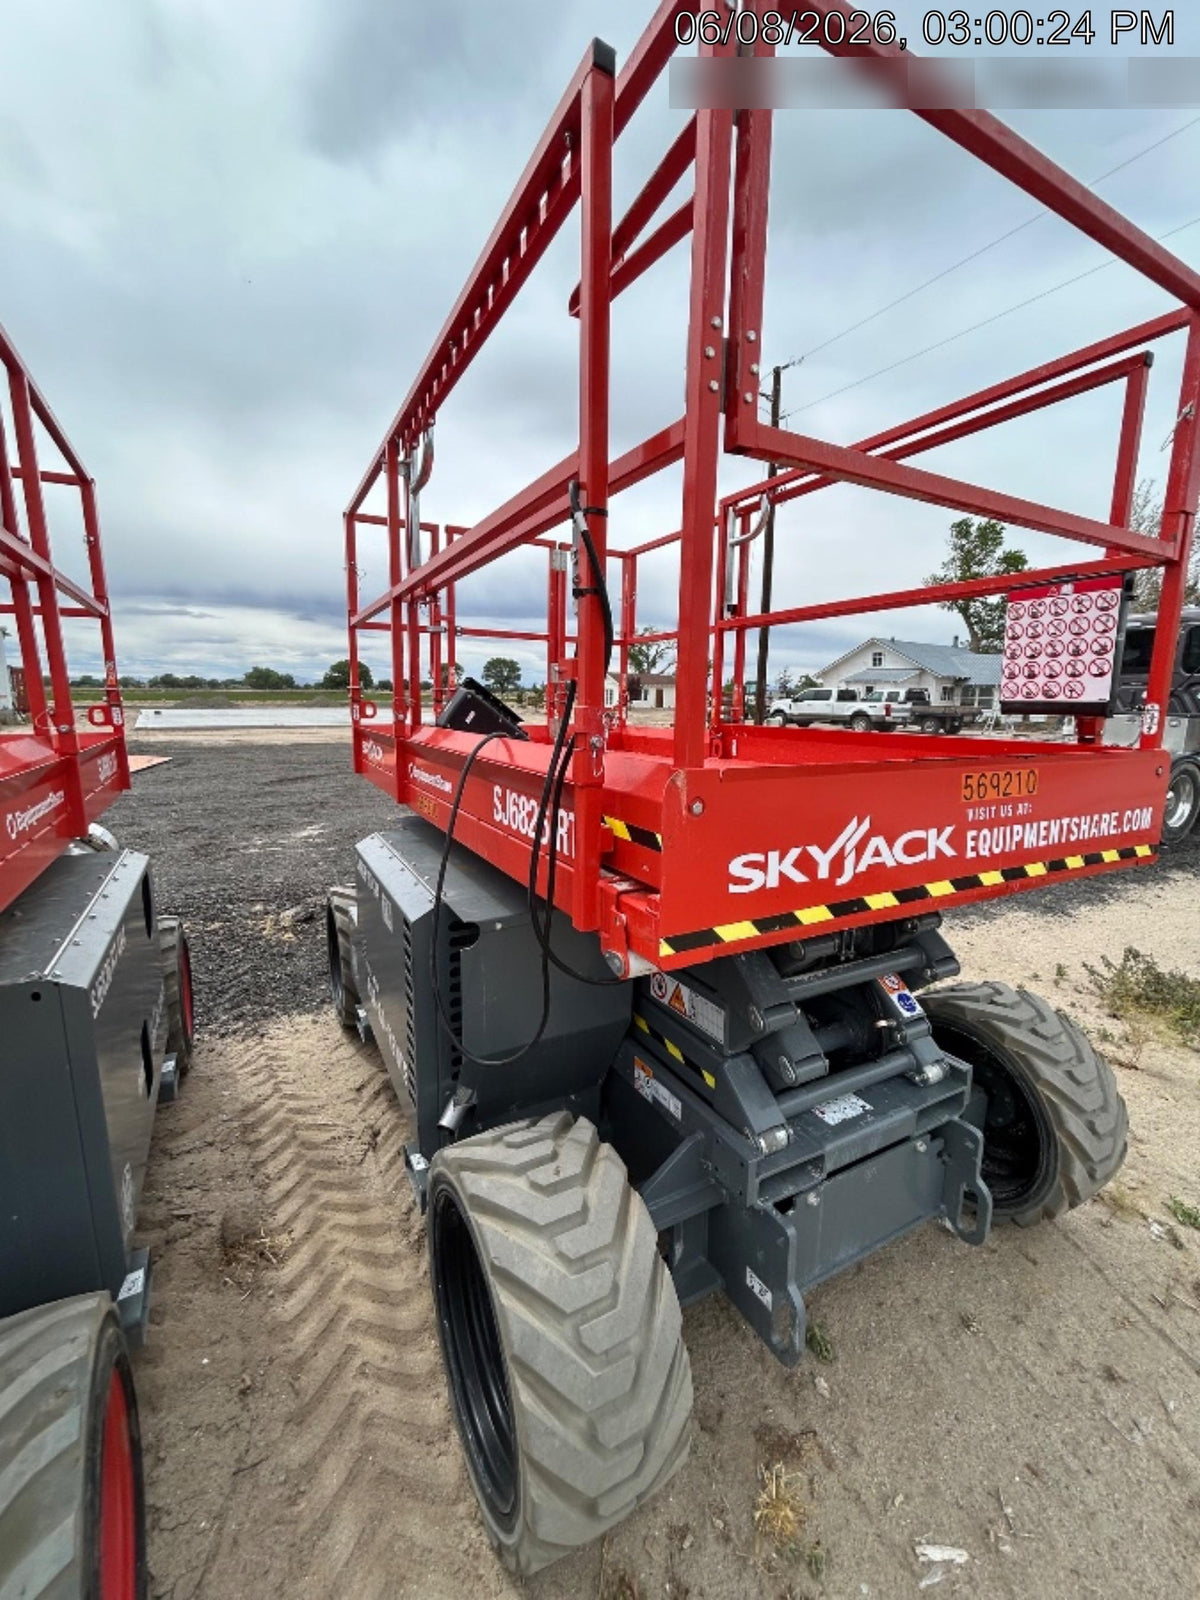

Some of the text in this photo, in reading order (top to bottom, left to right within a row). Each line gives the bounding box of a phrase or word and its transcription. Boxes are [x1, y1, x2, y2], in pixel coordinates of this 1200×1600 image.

[962, 769, 1037, 801] 569210
[965, 807, 1154, 859] EQUIPMENTSHARE.COM
[967, 803, 1032, 822] VISIT US AT:
[727, 816, 958, 894] SKYJACK
